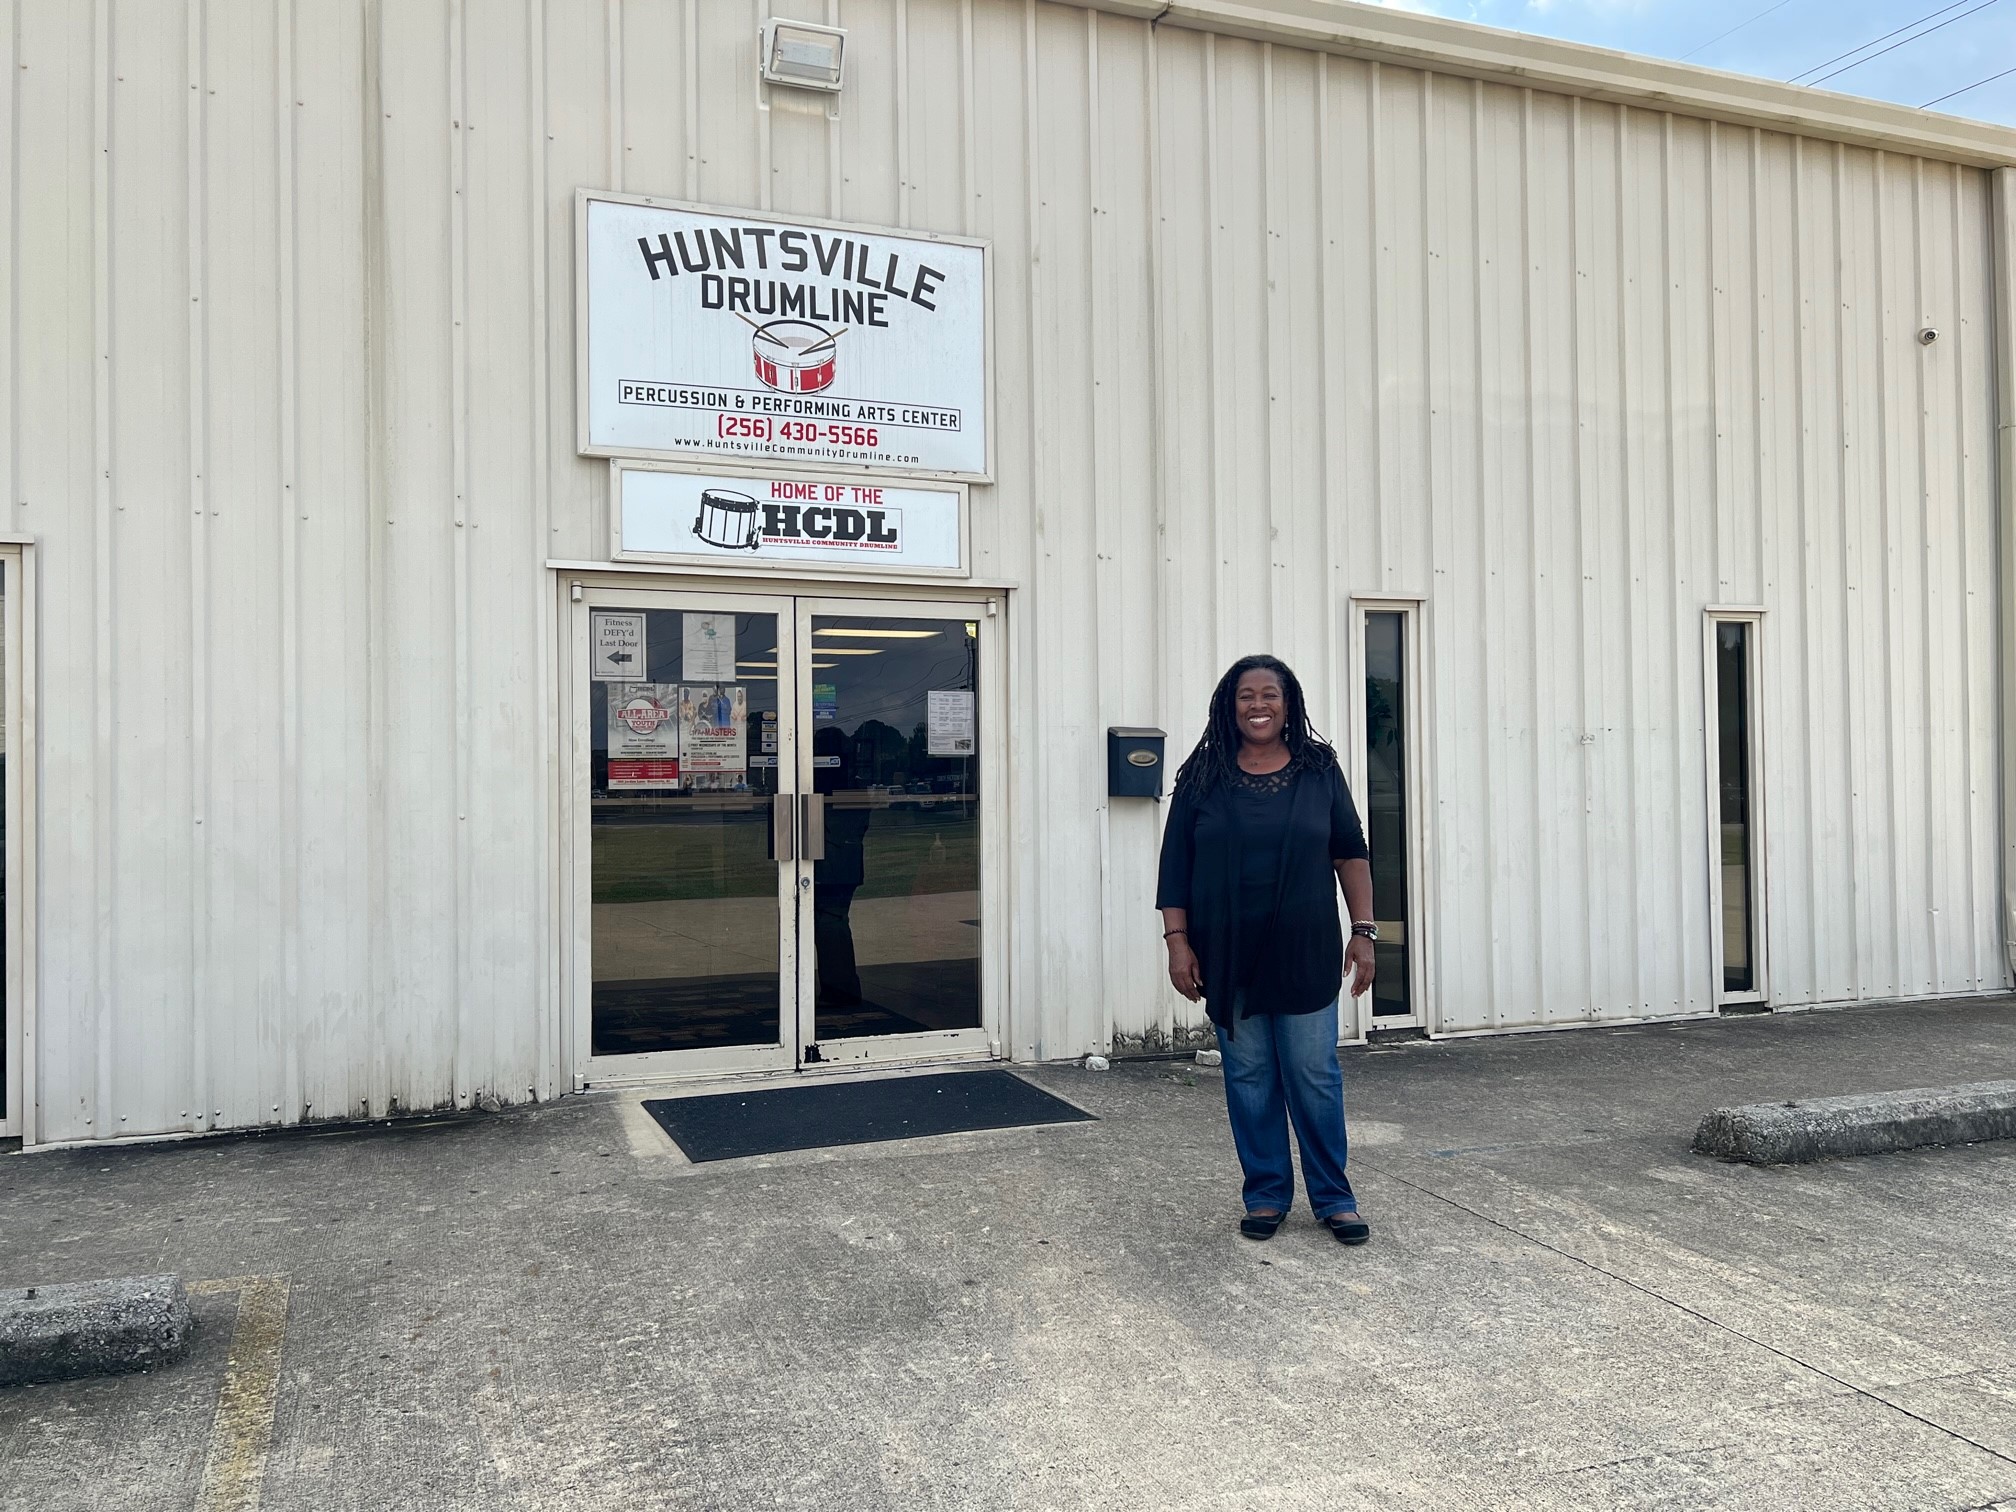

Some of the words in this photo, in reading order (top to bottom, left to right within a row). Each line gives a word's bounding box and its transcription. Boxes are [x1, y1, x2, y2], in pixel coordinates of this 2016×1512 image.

[637, 227, 946, 312] HUNTSVILLE
[701, 273, 889, 328] DRUMLINE
[623, 385, 728, 408] PERCUSSION
[735, 394, 745, 409] &
[752, 396, 850, 418] PERFORMING
[857, 405, 896, 422] ARTS
[902, 409, 958, 428] CENTER
[718, 413, 772, 443] (256)
[780, 421, 878, 447] 430-5566
[674, 438, 919, 463] www.HuntsvilleCommunityDrumline.com
[771, 481, 818, 500] HOME
[824, 485, 845, 502] OF
[851, 487, 884, 505] THE
[762, 504, 898, 543] HCDL
[762, 537, 811, 545] HUNTSVILLE
[812, 540, 858, 548] COMMUNITY
[859, 542, 898, 550] DRUMLINE
[605, 618, 633, 627] Fitness
[600, 639, 617, 647] Last
[618, 639, 639, 648] Door
